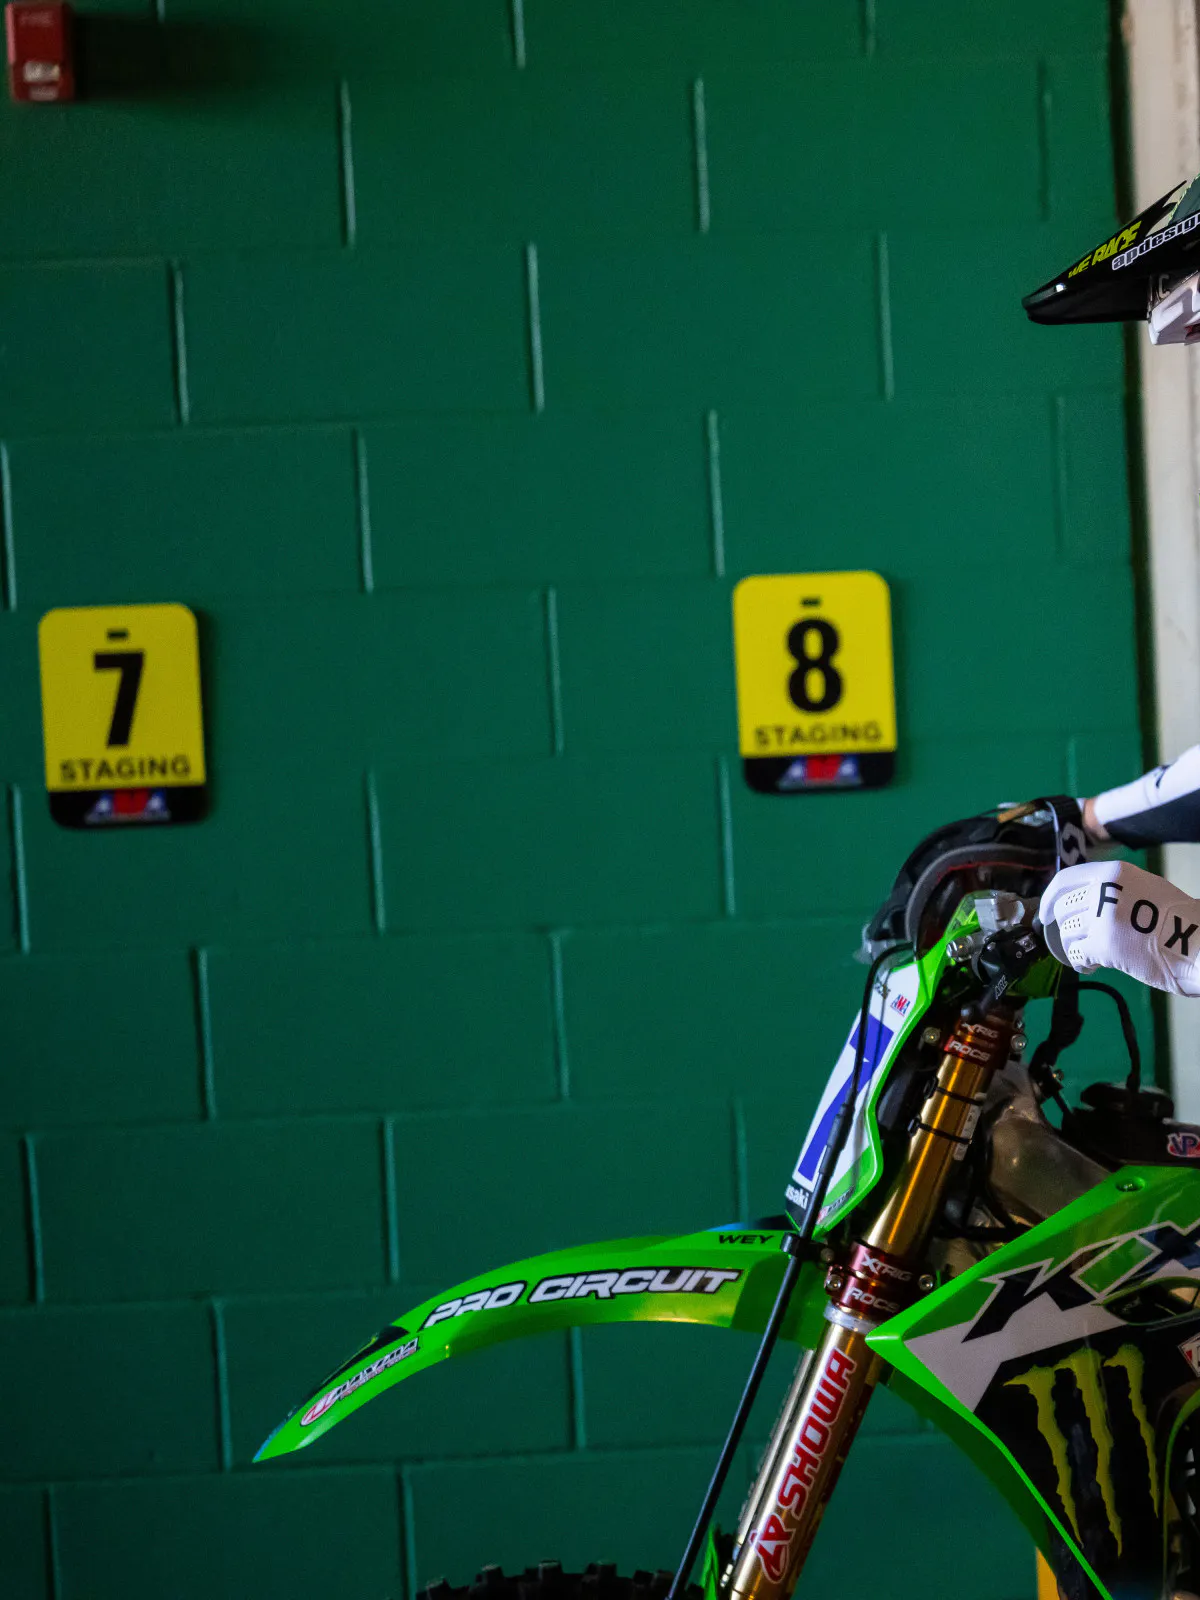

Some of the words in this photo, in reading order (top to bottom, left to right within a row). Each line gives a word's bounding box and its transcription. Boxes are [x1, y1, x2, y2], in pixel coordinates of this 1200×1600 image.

[1068, 255, 1092, 278] WE
[1091, 220, 1142, 266] RACE
[785, 615, 844, 714] 8
[93, 650, 145, 750] 7
[754, 721, 882, 748] STAGING
[60, 754, 190, 782] STAGING
[1096, 881, 1200, 956] FOX
[949, 1040, 992, 1062] ROCS
[1168, 1132, 1200, 1157] VP
[785, 1183, 811, 1210] saki
[860, 1252, 914, 1282] XTRIG
[421, 1281, 527, 1330] PRO
[529, 1268, 745, 1304] CIRCUIT
[848, 1285, 900, 1314] ROCS
[777, 1347, 857, 1521] SHOWA
